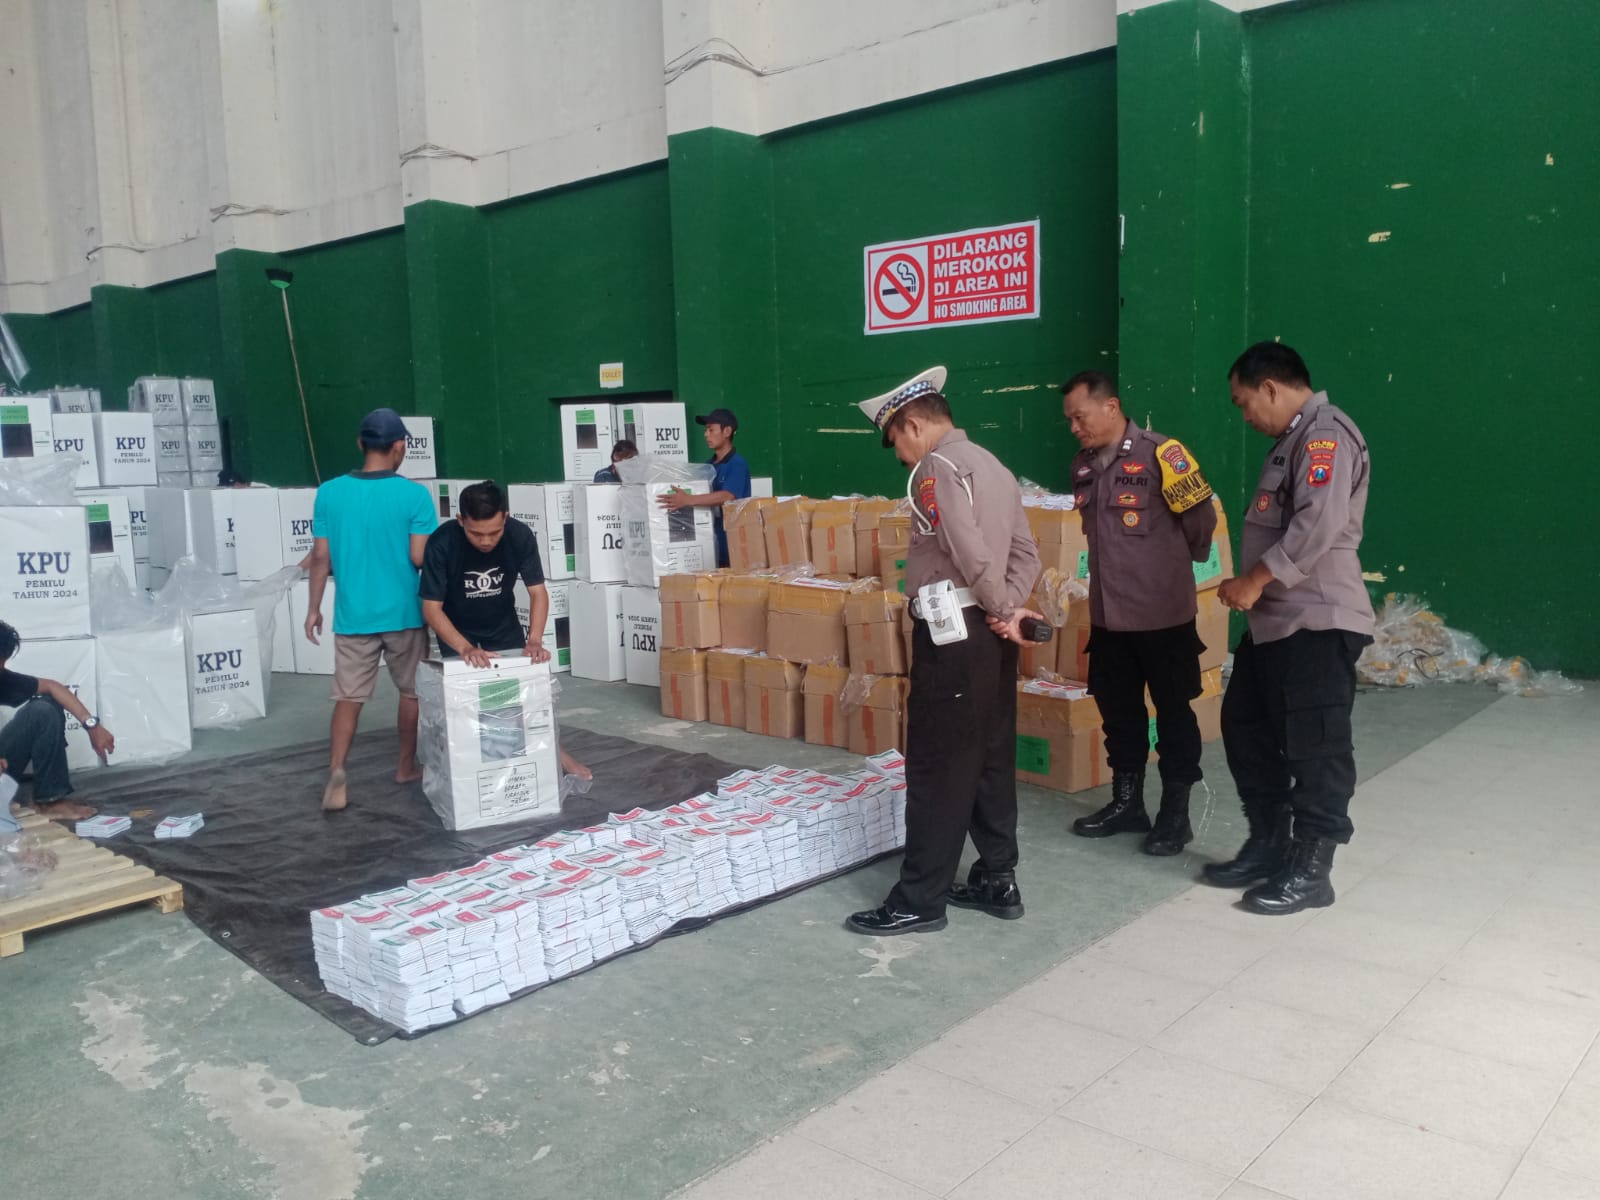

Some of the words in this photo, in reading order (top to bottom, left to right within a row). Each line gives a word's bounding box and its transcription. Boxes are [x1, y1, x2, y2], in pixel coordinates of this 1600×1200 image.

[934, 232, 1027, 260] DILARANG
[934, 251, 1026, 279] MEROKOK
[934, 282, 949, 296] DI
[954, 275, 999, 293] AREA
[1004, 271, 1027, 287] INI
[934, 304, 947, 319] NO
[950, 298, 997, 317] SMOKING
[1000, 295, 1027, 311] AREA
[155, 394, 175, 403] KPU
[192, 394, 210, 404] KPU
[655, 428, 680, 442] KPU
[53, 438, 84, 452] KPU
[116, 437, 146, 450] KPU
[161, 440, 181, 450] KPU
[197, 440, 216, 450] KPU
[406, 438, 427, 449] KPU
[1114, 476, 1148, 487] POLRI
[602, 532, 623, 550] PU
[17, 551, 71, 575] KPU
[25, 579, 66, 588] PEMILU
[13, 590, 49, 599] TAHUN
[53, 589, 78, 598] 2024
[632, 633, 657, 652] KPU
[196, 649, 242, 674] KPU
[204, 673, 239, 683] PEMILU
[195, 683, 226, 695] TAHUN
[228, 680, 250, 691] 2024
